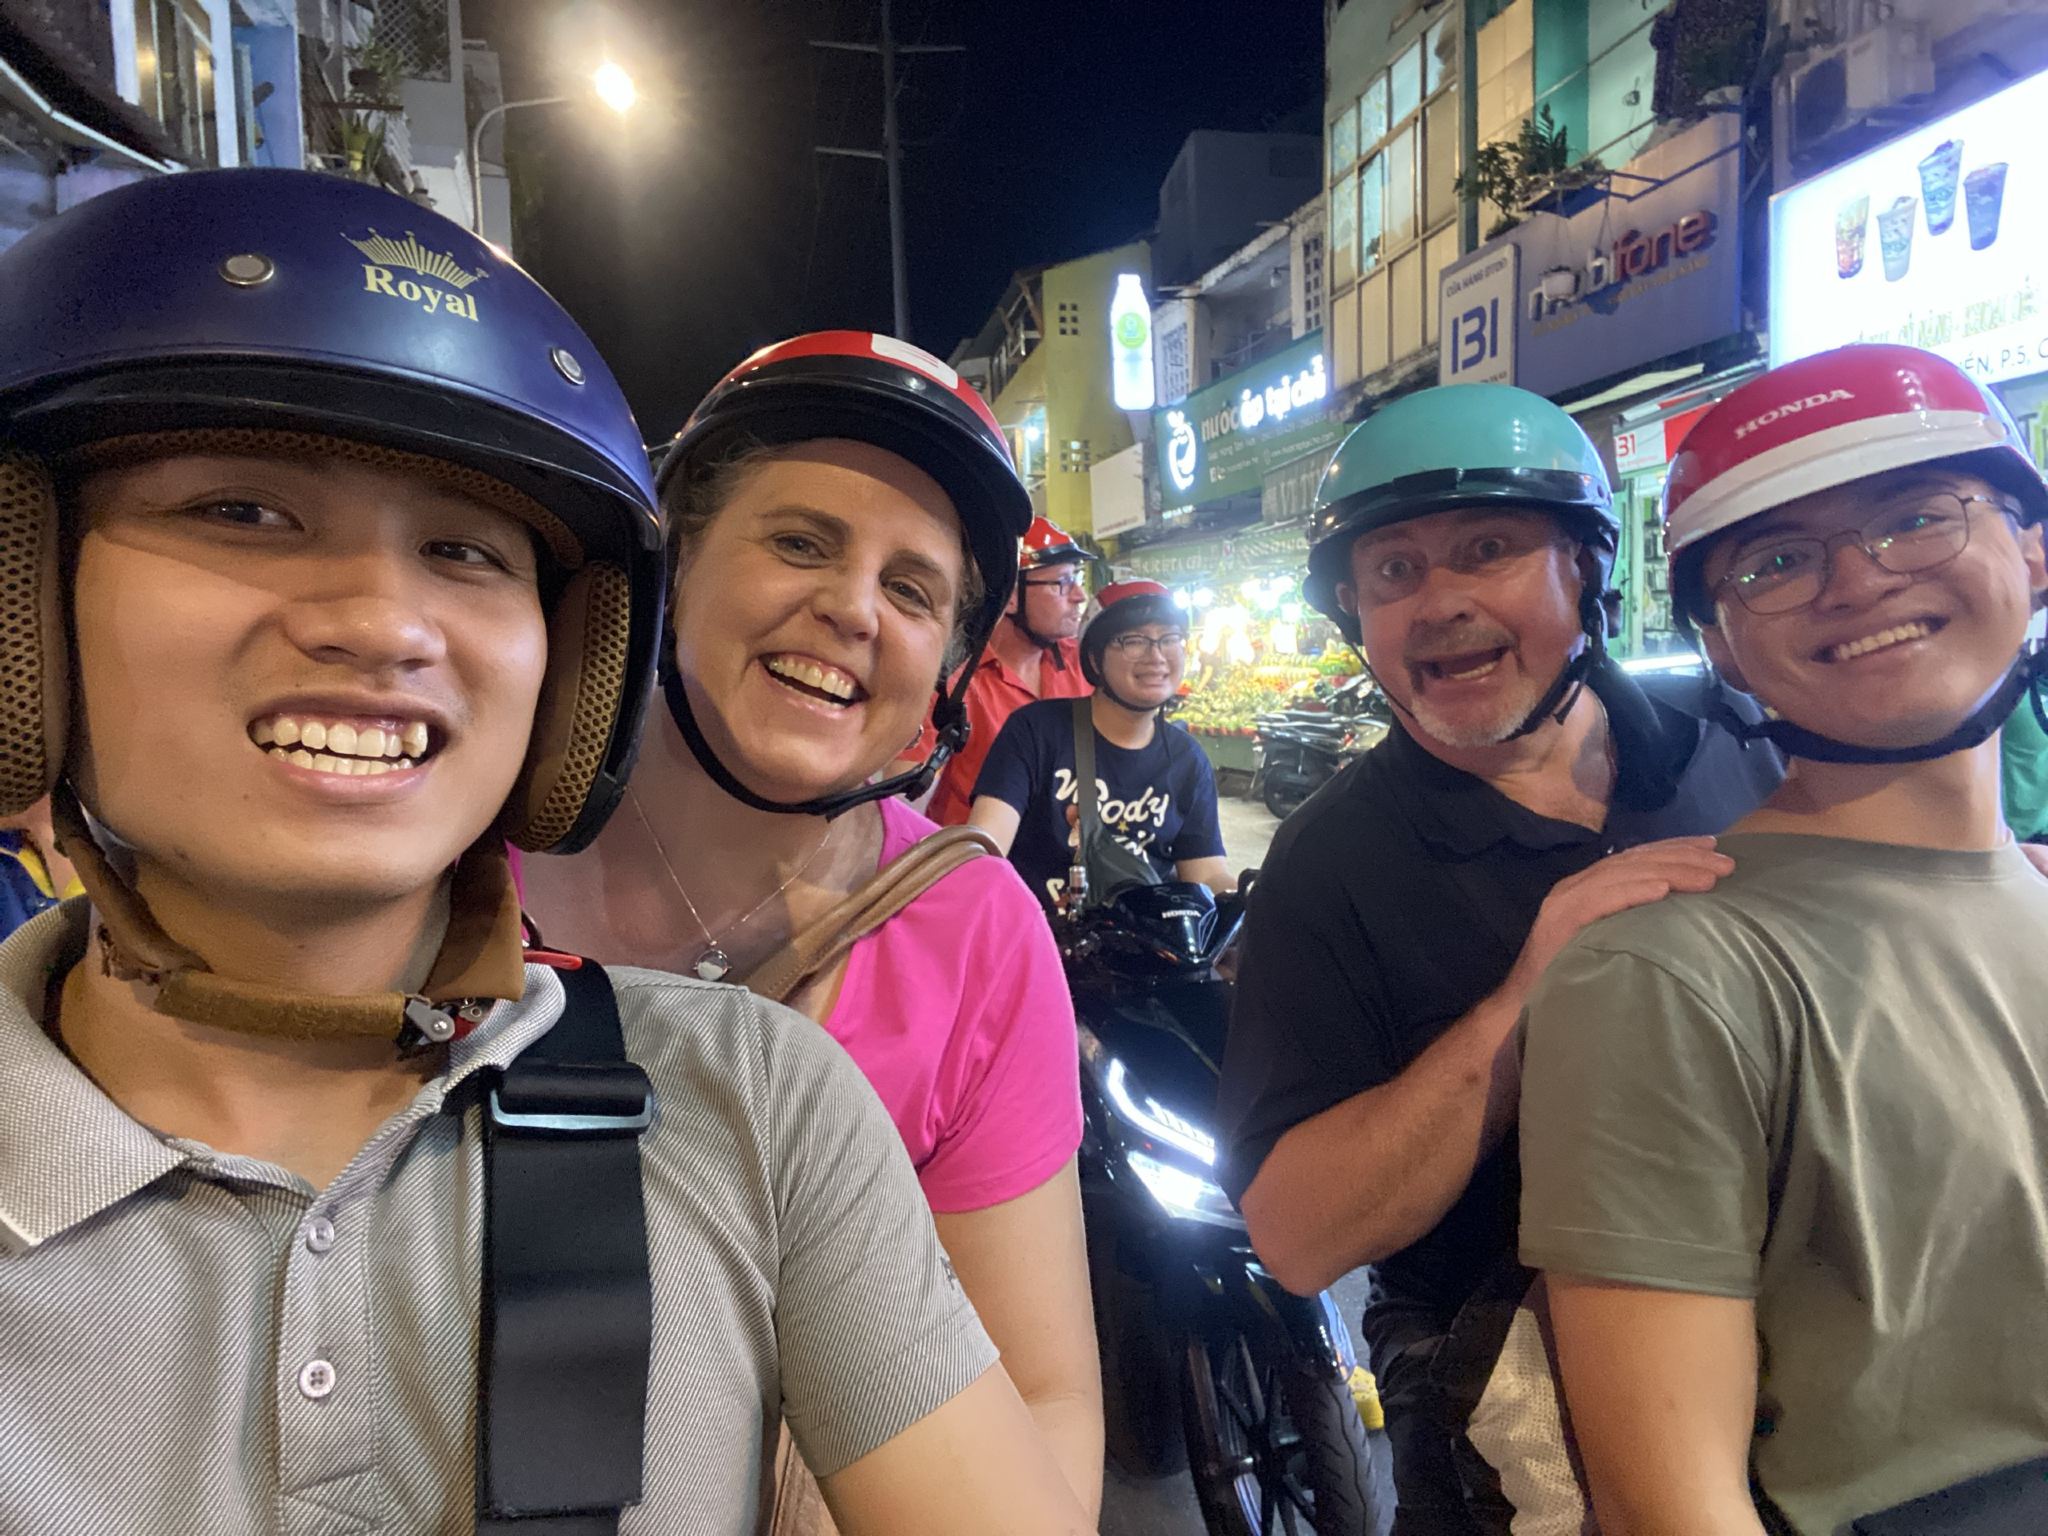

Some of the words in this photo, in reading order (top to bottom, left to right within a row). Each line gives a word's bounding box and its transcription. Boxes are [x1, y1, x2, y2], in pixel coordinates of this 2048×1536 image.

[362, 264, 478, 322] Royal
[1528, 210, 1716, 320] mbifone
[1734, 389, 1855, 439] HONDA
